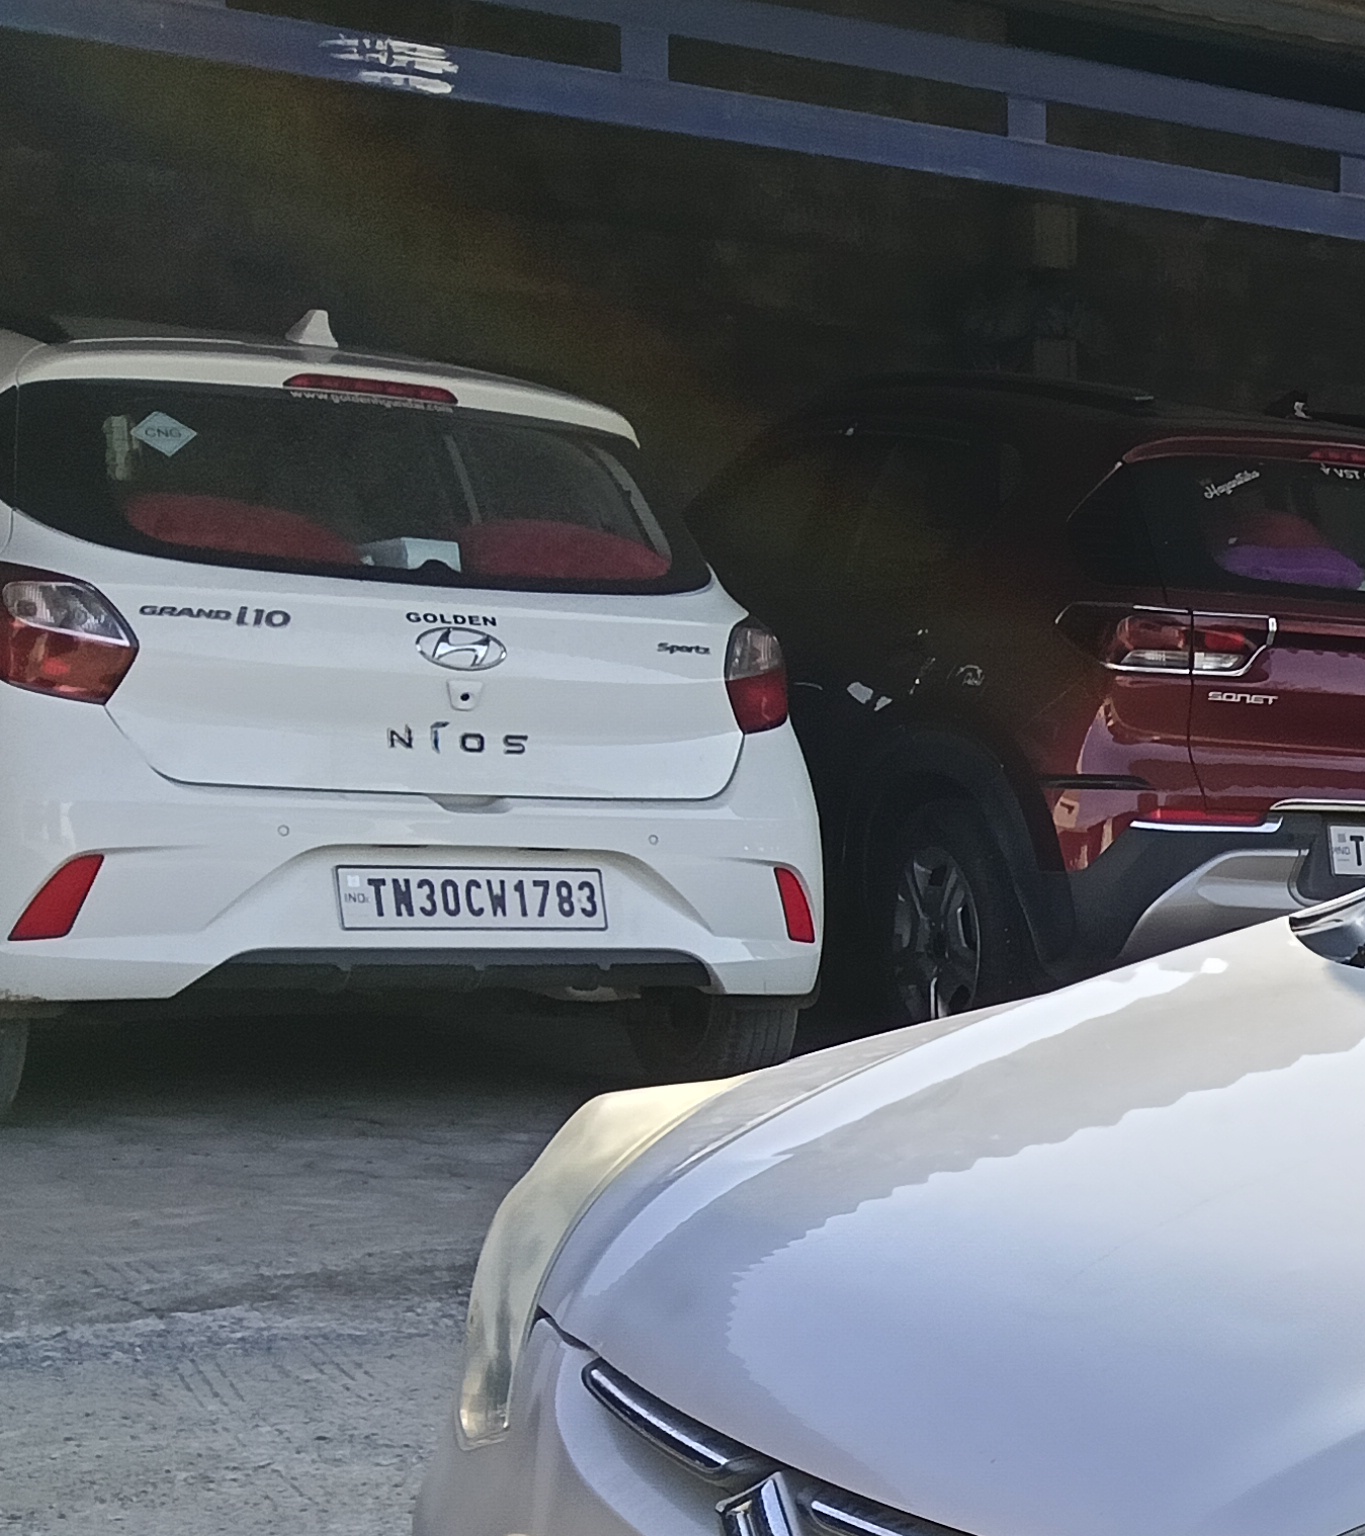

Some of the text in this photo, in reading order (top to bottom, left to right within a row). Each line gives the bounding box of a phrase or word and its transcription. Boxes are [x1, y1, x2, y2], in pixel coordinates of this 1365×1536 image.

[144, 427, 182, 438] CNG
[1333, 467, 1360, 480] VST
[138, 604, 233, 621] GRAND
[405, 611, 498, 627] GOLDEN
[656, 642, 711, 656] Sportz
[1207, 691, 1279, 705] SONET
[366, 877, 598, 918] TN30CW1783
